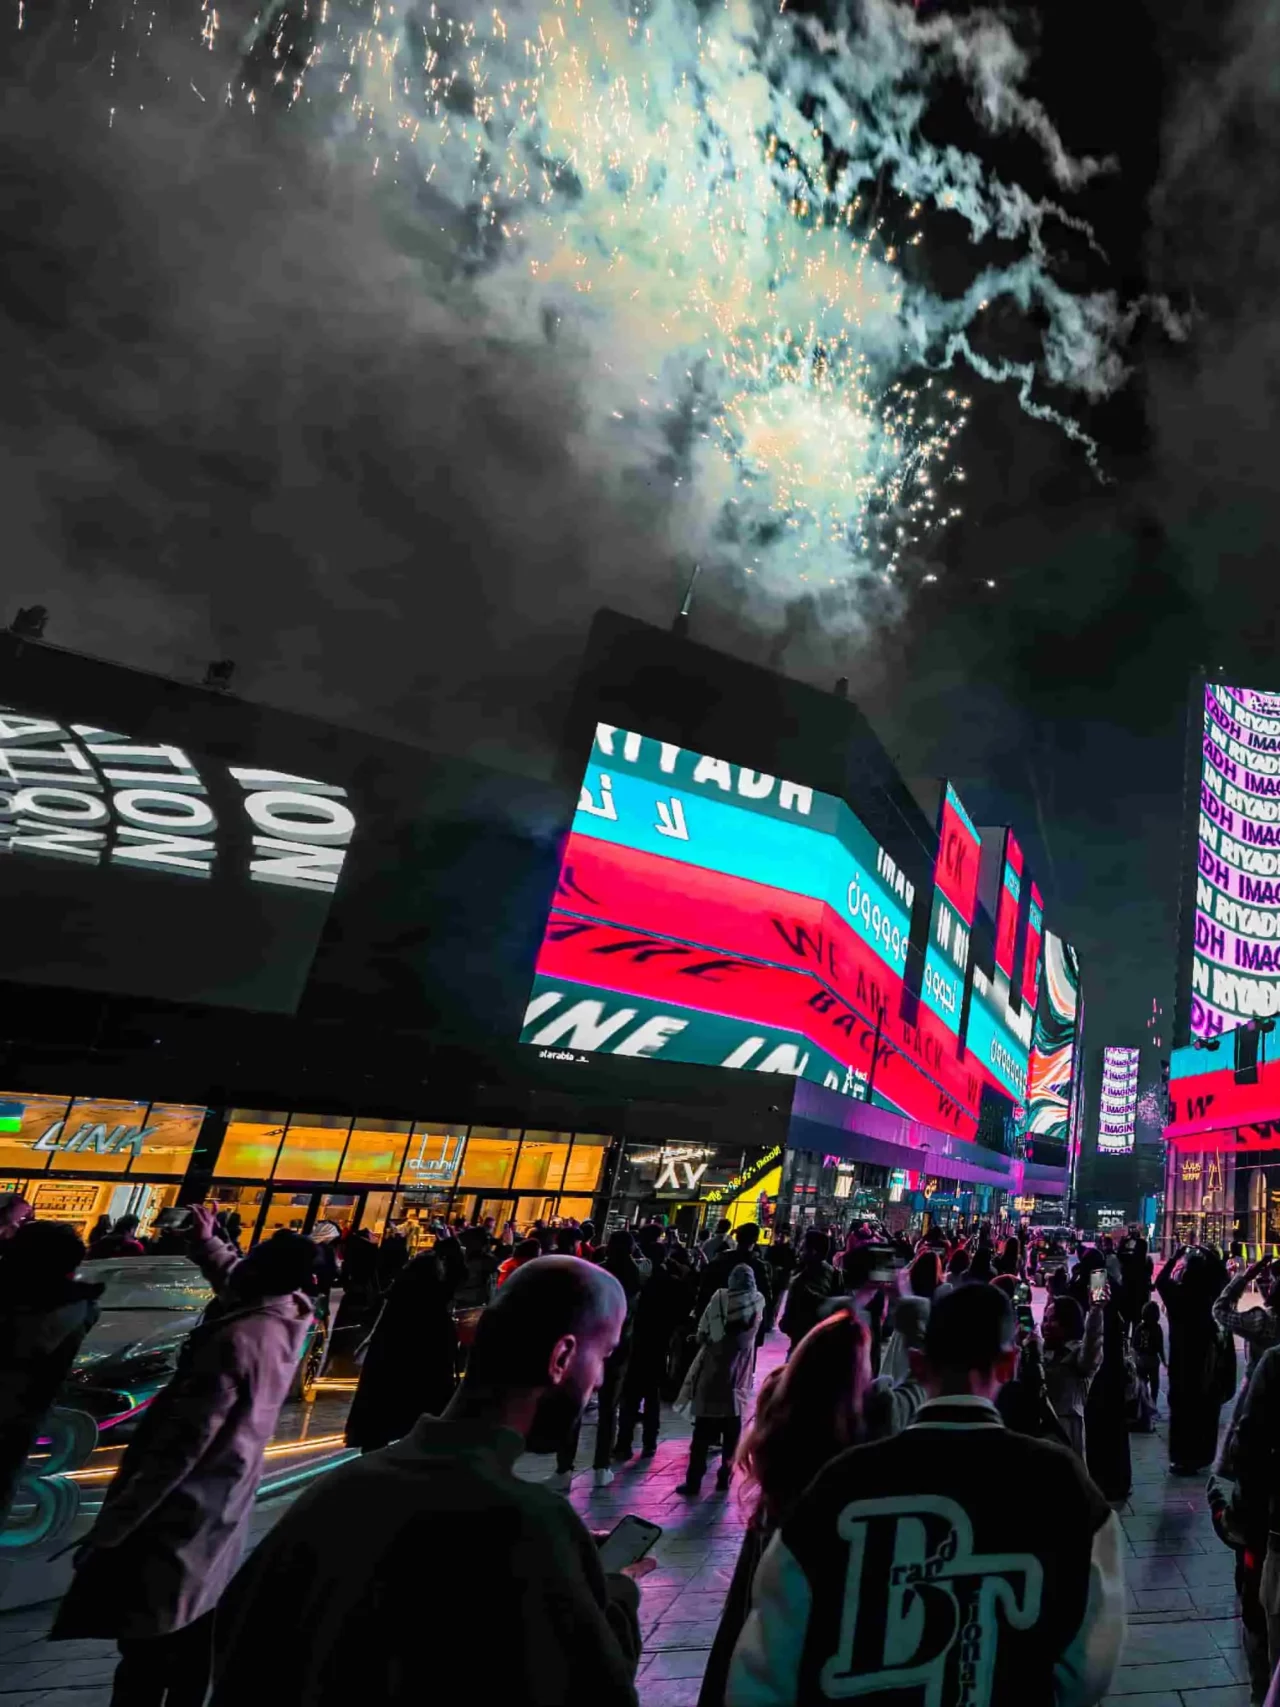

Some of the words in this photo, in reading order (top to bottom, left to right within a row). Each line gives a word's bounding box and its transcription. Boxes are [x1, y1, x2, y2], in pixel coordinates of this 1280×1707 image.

[1203, 734, 1236, 781] ADH
[1197, 877, 1212, 912] N
[1193, 956, 1209, 996] N
[808, 989, 898, 1068] BACK
